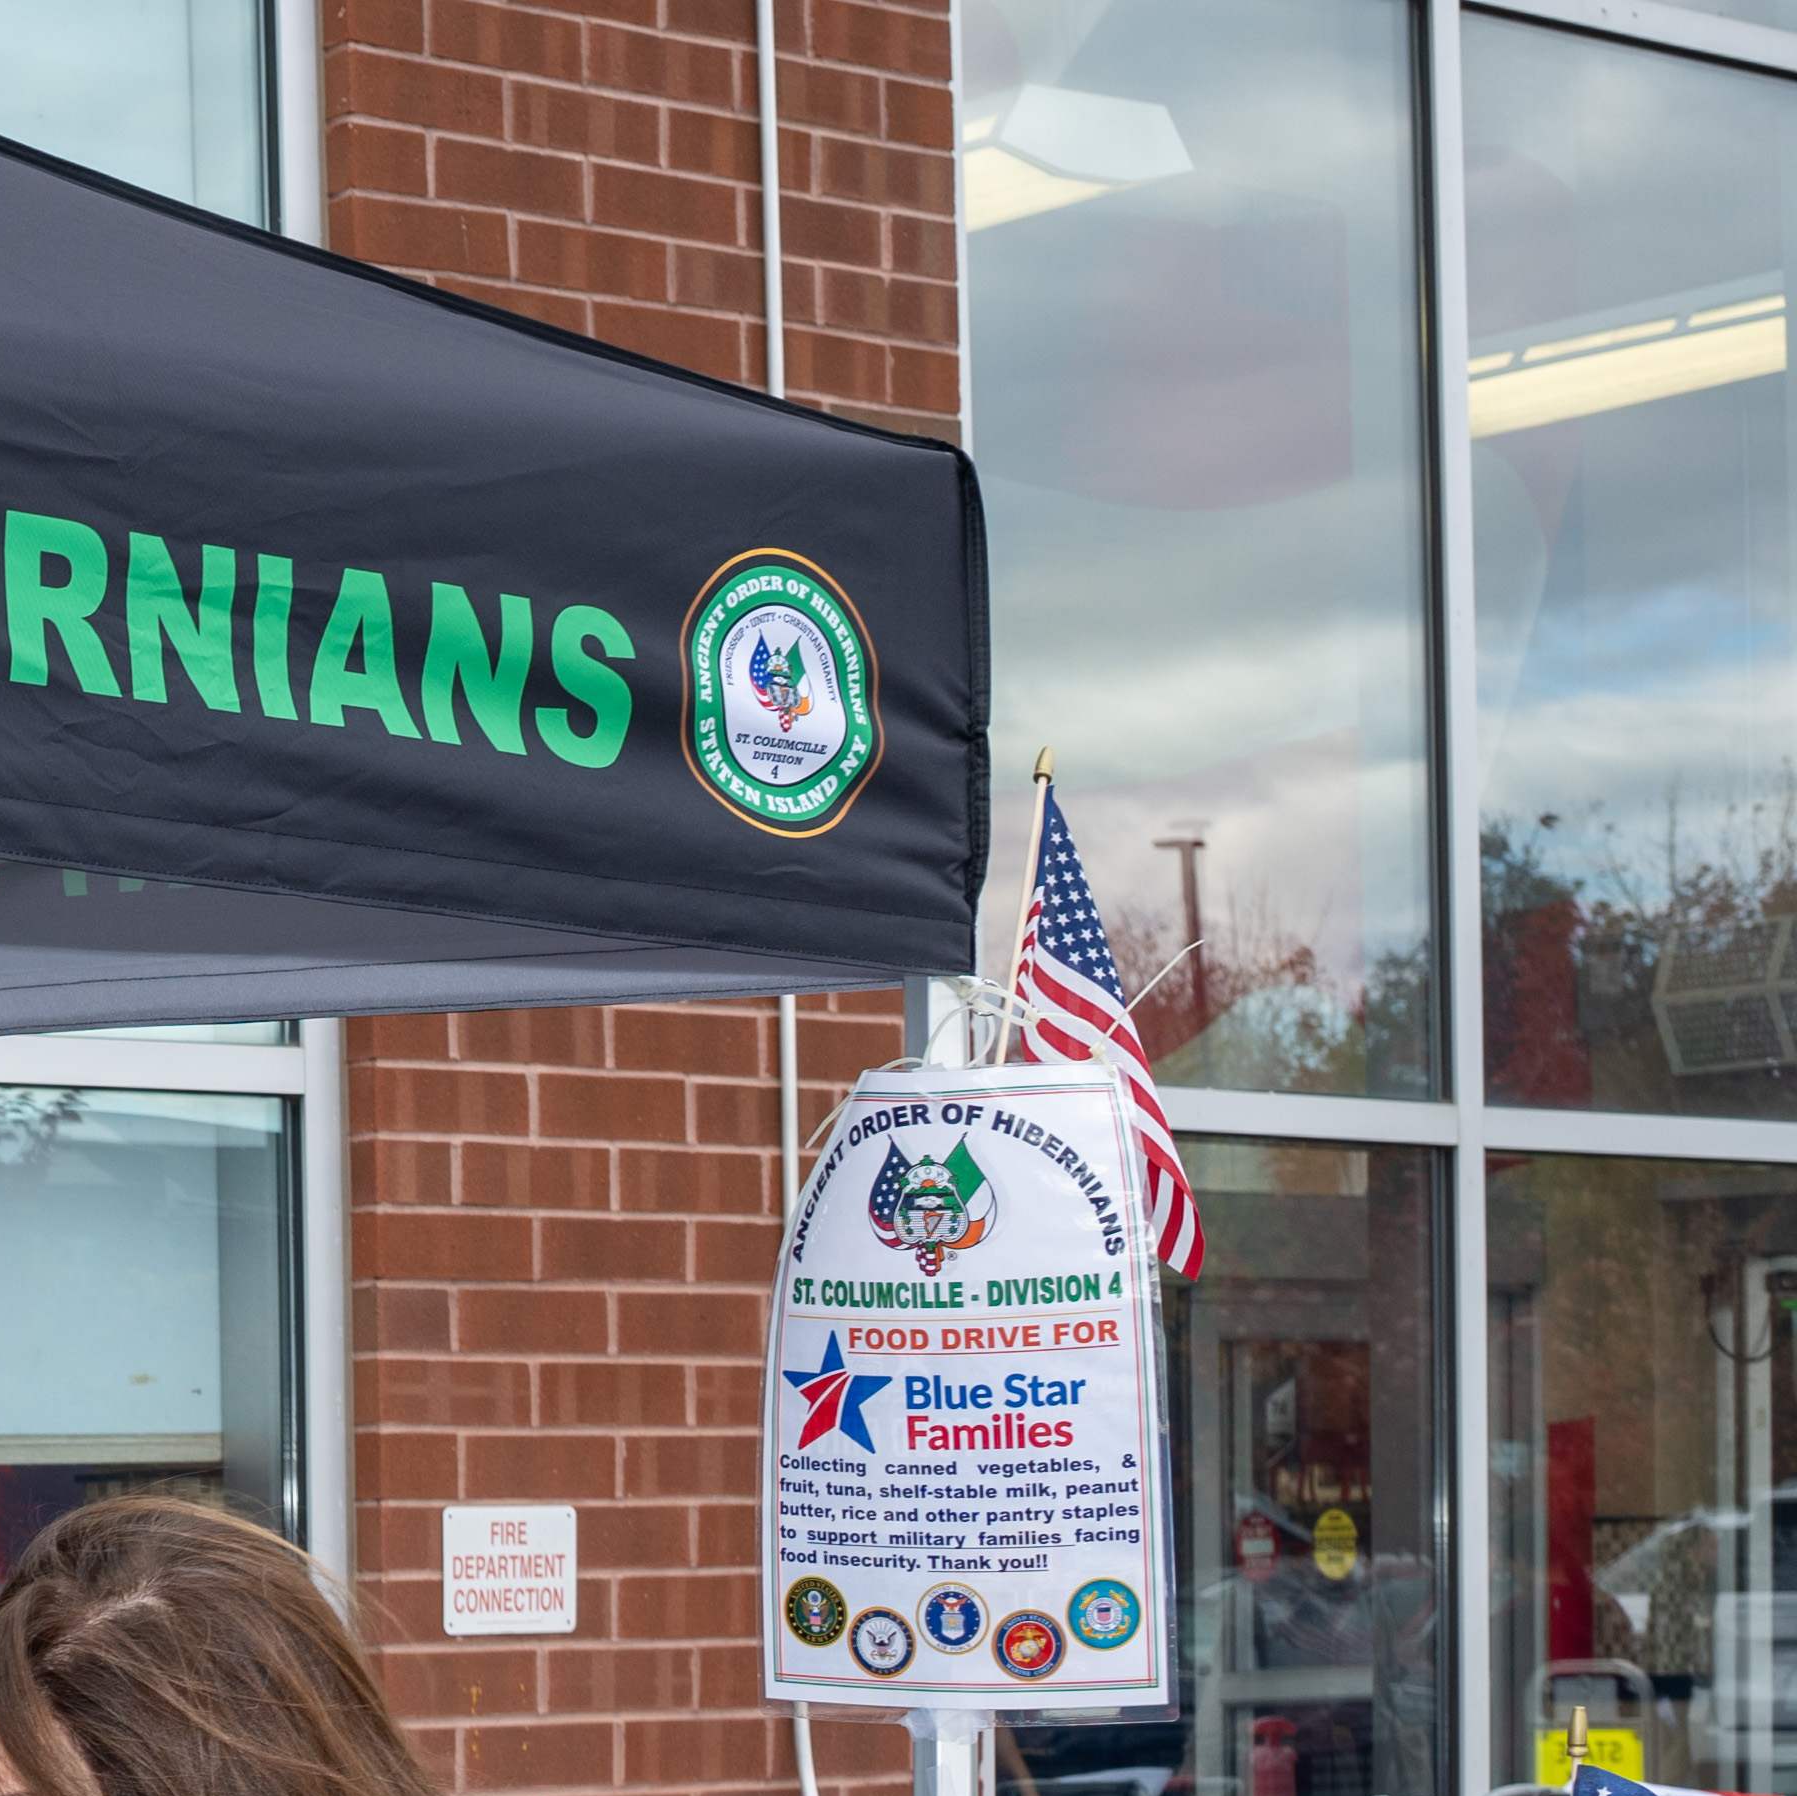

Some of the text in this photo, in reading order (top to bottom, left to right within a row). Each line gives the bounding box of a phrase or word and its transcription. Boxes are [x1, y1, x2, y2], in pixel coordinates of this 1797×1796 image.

[699, 575, 866, 725] ANCIENT ORDER OF HIBERNIANS
[749, 612, 777, 629] UNITY
[783, 614, 824, 656] CHRISTIAN
[820, 653, 838, 703] CHARITY
[735, 733, 828, 755] ST. COLUMCILLE
[699, 717, 867, 815] STATEN ISLAND NY
[752, 751, 804, 766] DIVISION
[771, 765, 779, 780] 4
[793, 1103, 1126, 1263] ANCIENT ORDER OF HIBERNIANS
[793, 1271, 1123, 1309] ST. COLUMCILLE DIVISION 4
[848, 1320, 1119, 1350] FOOD DRIVE FOR
[905, 1373, 1086, 1410] Blue Star
[907, 1413, 1073, 1451] Families
[780, 1453, 1137, 1478] Collecting canned vegetables, &
[780, 1478, 1139, 1500] fruit, tuna, shelf-stable milk, peanut
[780, 1502, 1139, 1526] butter, rice and other pantry staples
[490, 1521, 528, 1546] FIRE
[780, 1526, 1140, 1549] to support military families facing
[452, 1554, 565, 1580] DEPARTMENT
[780, 1550, 1049, 1573] food insecurity. Thank you!!
[454, 1587, 564, 1613] CONNECTION
